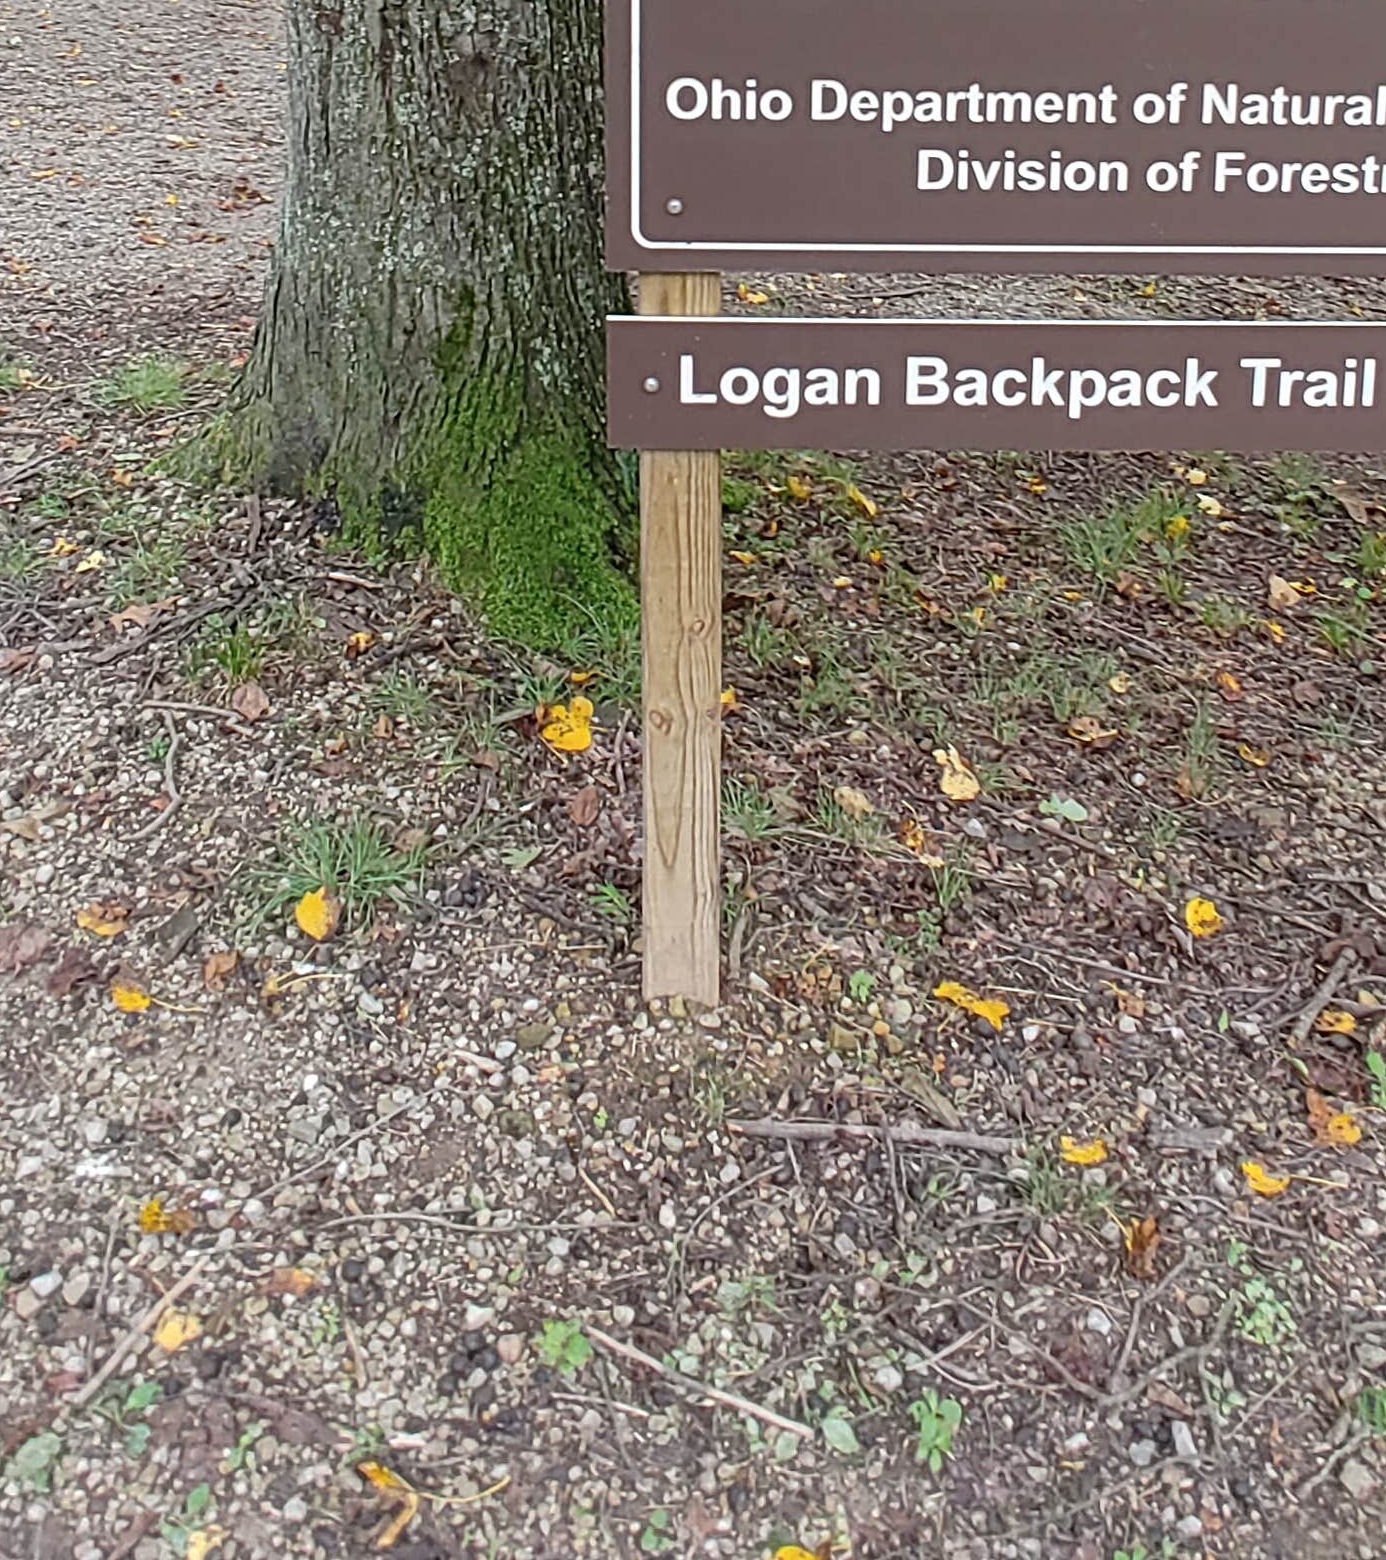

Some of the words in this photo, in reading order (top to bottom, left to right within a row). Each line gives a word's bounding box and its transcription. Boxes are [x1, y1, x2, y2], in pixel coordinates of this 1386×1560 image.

[664, 76, 794, 122] Ohio
[810, 78, 1119, 133] Department
[1132, 81, 1190, 125] of
[916, 148, 1130, 193] Division
[1145, 149, 1203, 193] of
[679, 353, 882, 420] Logan
[904, 355, 1220, 421] Backpack
[1238, 357, 1378, 409] Trail
